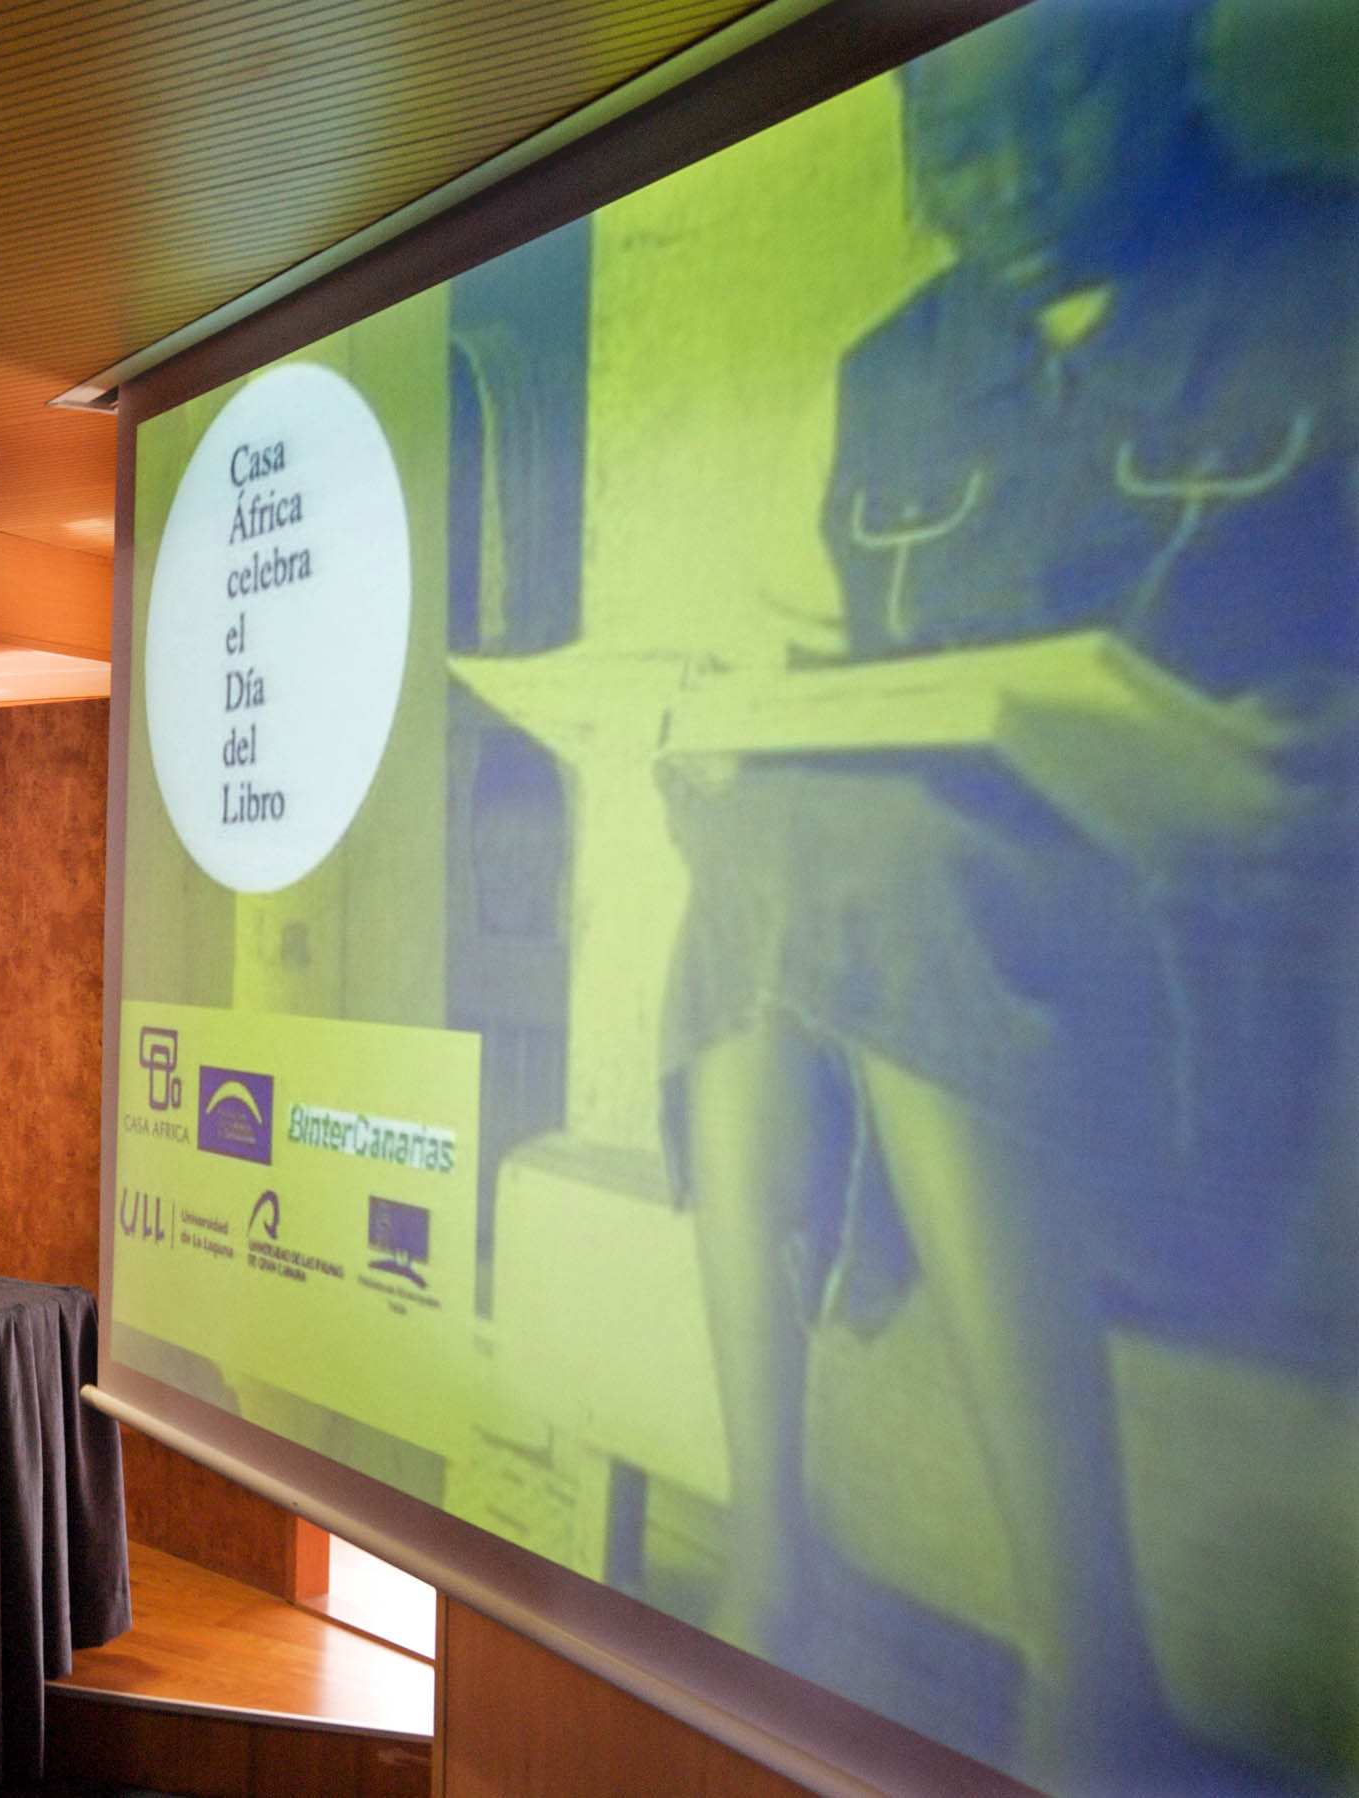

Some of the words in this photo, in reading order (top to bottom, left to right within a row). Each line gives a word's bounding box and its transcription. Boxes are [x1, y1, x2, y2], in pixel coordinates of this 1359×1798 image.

[230, 441, 285, 487] Casa
[229, 489, 302, 545] África
[227, 547, 312, 599] celebra
[226, 612, 245, 655] el
[225, 667, 264, 711] Día
[223, 723, 256, 767] del
[222, 781, 285, 824] Libro
[123, 1114, 149, 1135] CASA
[152, 1120, 190, 1144] AFRICA
